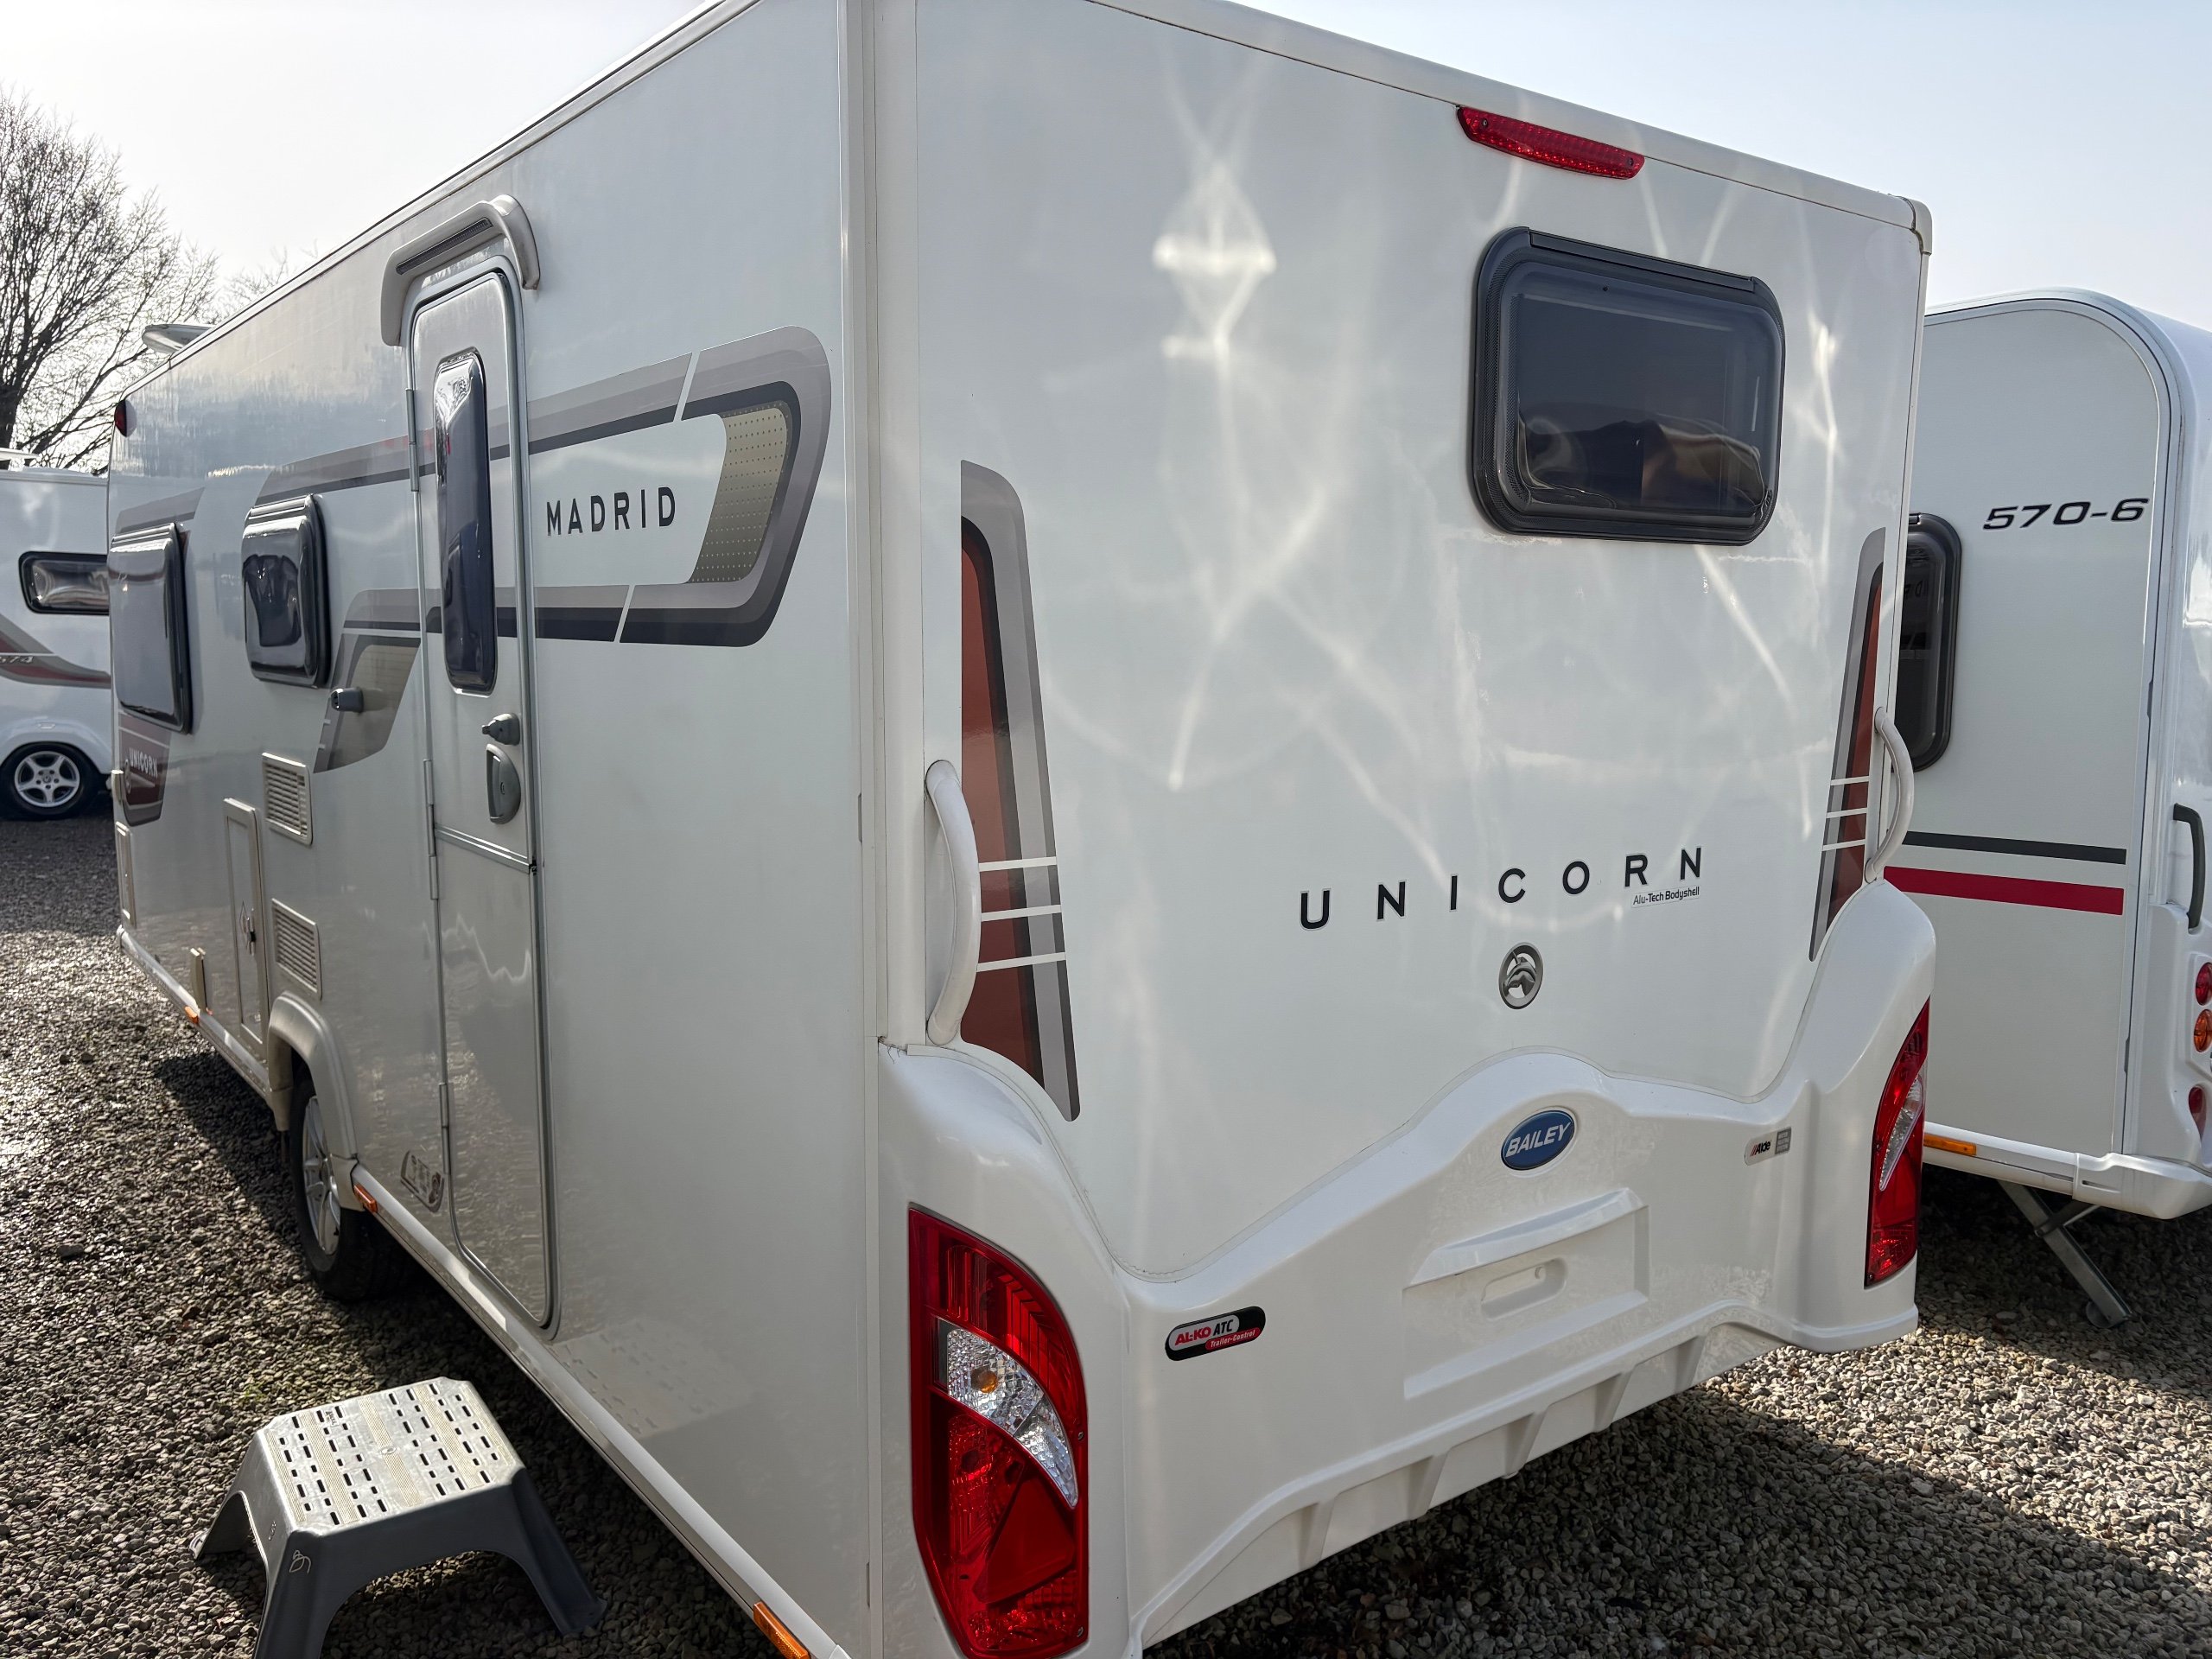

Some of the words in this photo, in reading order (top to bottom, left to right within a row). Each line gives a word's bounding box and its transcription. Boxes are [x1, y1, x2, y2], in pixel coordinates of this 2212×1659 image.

[546, 486, 676, 536] MADRID
[1983, 498, 2150, 530] 570-6
[129, 747, 158, 778] UNICORN
[1300, 847, 1701, 930] UNICORN
[1632, 891, 1664, 906] Alu-Tech
[1665, 886, 1700, 900] Bodyshell
[1505, 1122, 1572, 1158] BAILEY
[1212, 1319, 1234, 1337] ATC
